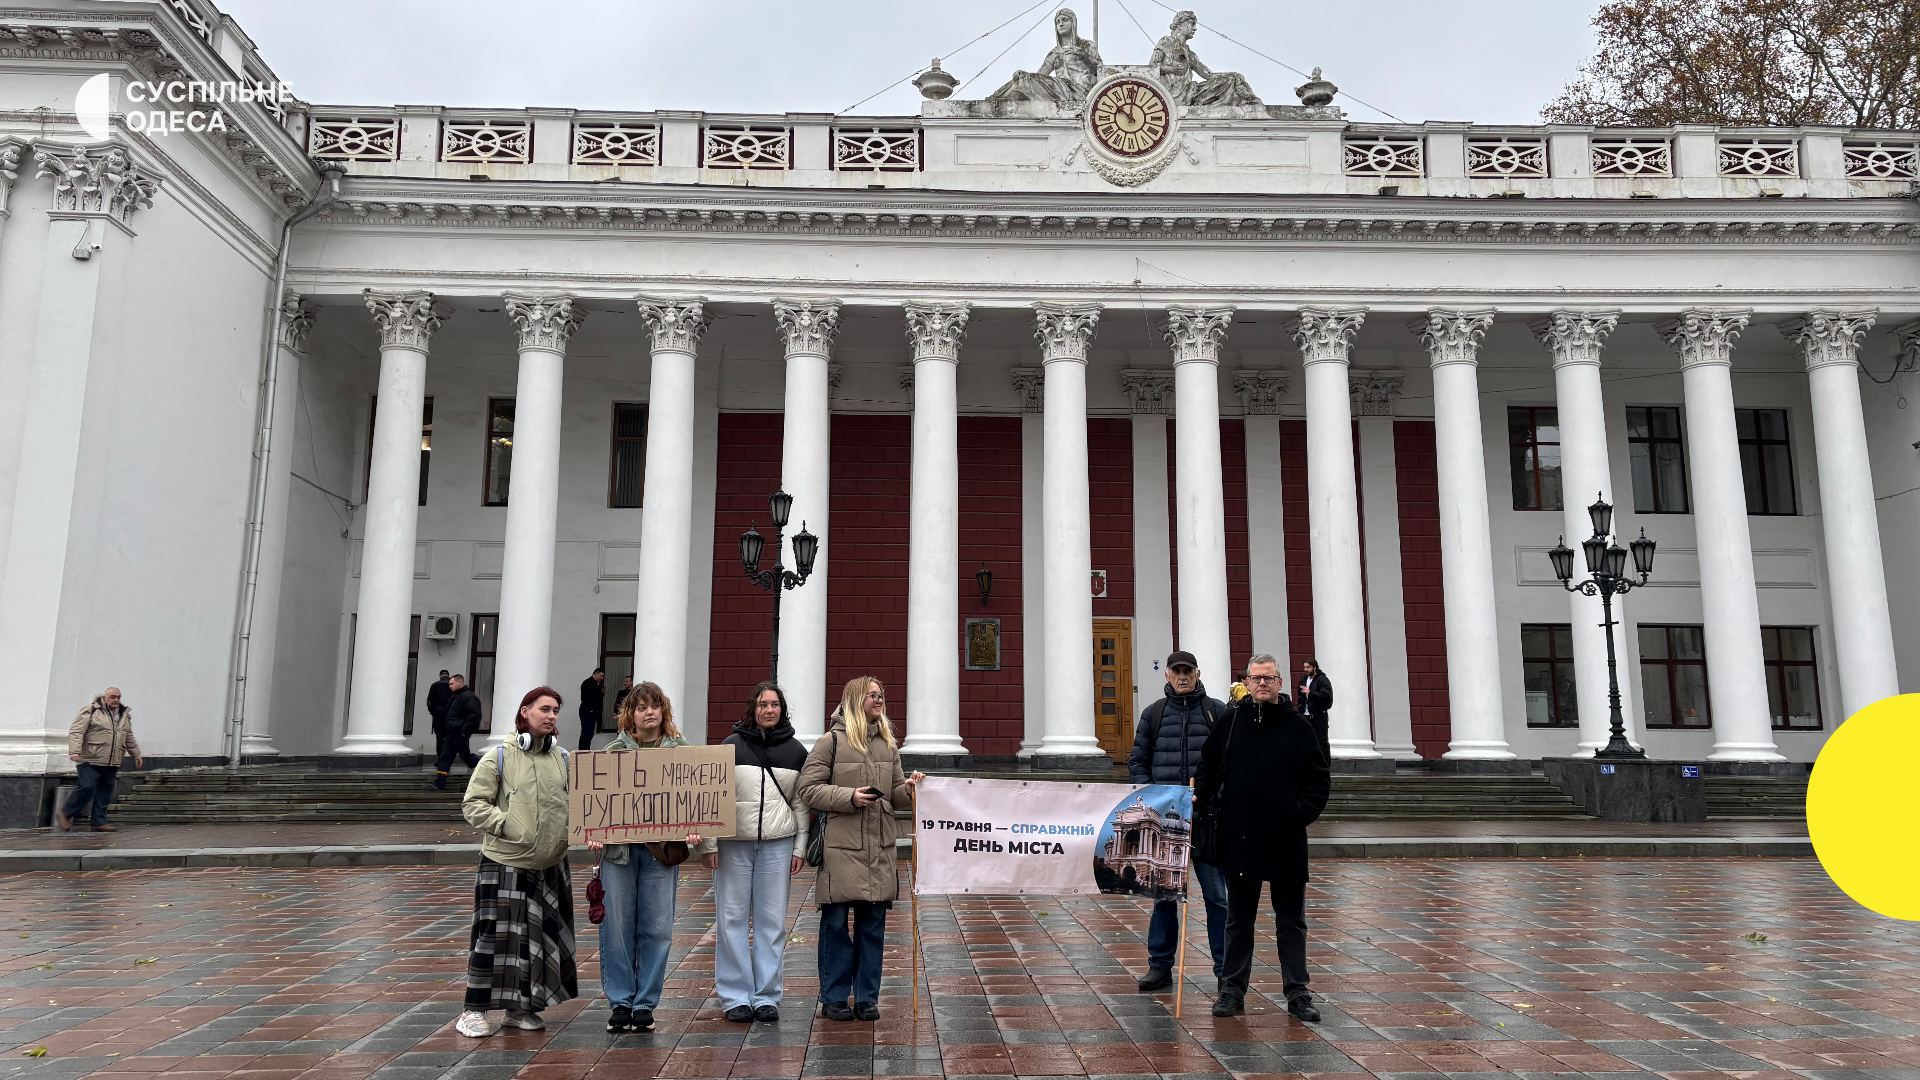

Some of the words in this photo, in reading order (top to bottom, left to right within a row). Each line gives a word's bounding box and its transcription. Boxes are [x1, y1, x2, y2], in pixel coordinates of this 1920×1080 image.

[575, 750, 647, 790] ГЕТЬ
[661, 762, 727, 787] МАРКЕРИ
[922, 820, 935, 830] 19
[938, 820, 992, 833] ТРАВНЯ
[1011, 822, 1095, 835] СПРАВЖНІЙ
[953, 837, 1004, 854] ДЕНЬ
[1008, 840, 1065, 855] МІСТА
